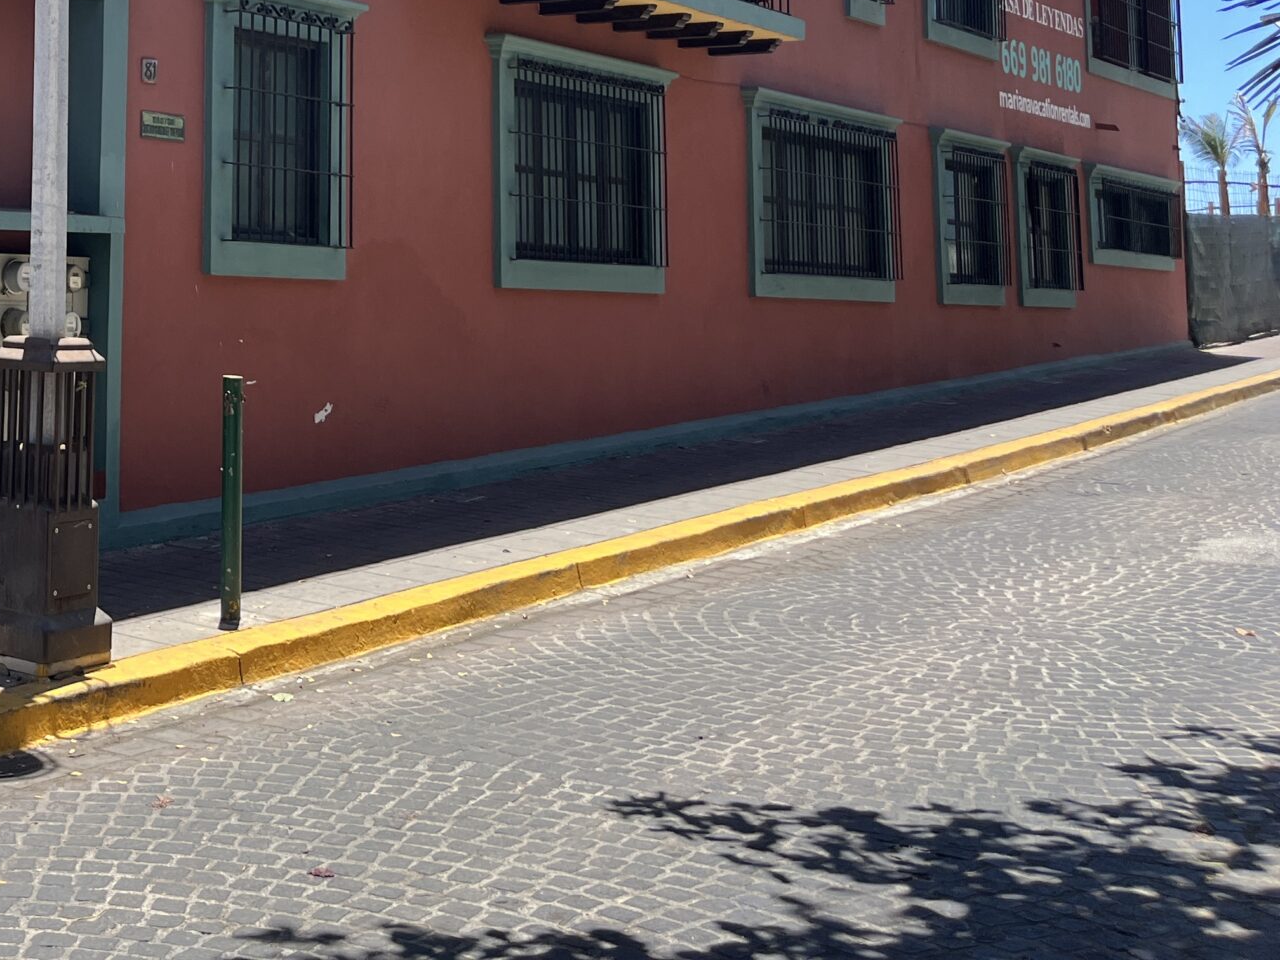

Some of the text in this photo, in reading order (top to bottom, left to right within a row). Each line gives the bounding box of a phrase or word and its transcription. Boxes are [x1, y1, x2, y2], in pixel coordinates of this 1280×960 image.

[1035, 2, 1083, 38] LEYENDAS
[1001, 39, 1081, 93] 669 981 6180
[999, 90, 1091, 128] marianavacationrentals.com
